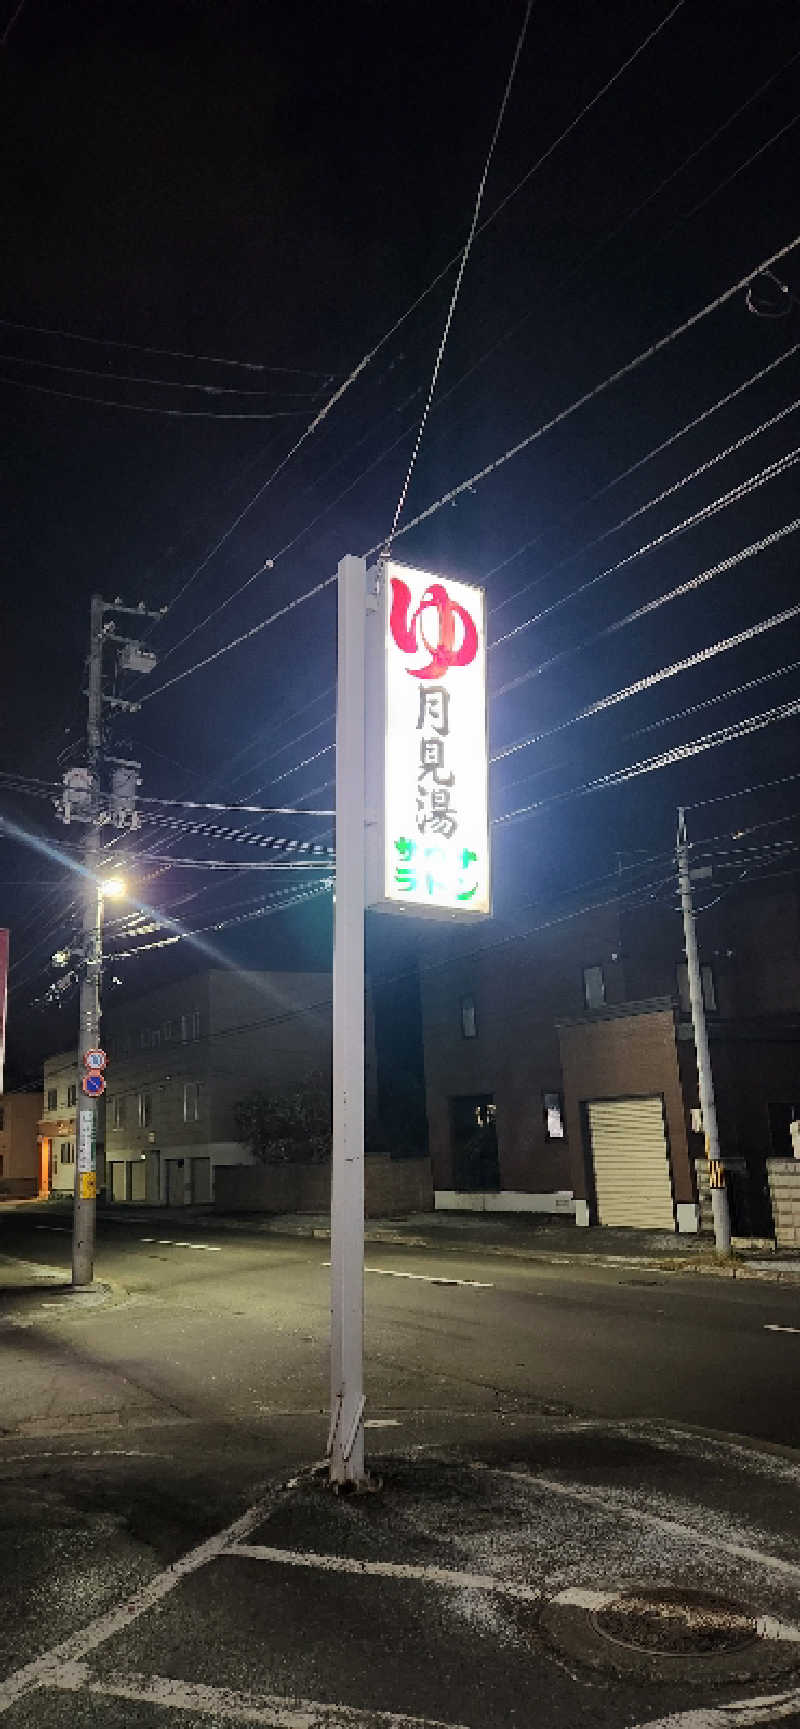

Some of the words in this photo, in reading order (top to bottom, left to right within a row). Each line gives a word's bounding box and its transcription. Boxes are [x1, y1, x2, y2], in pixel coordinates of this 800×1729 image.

[390, 577, 478, 679] ゆ
[416, 683, 457, 839] 月見湯
